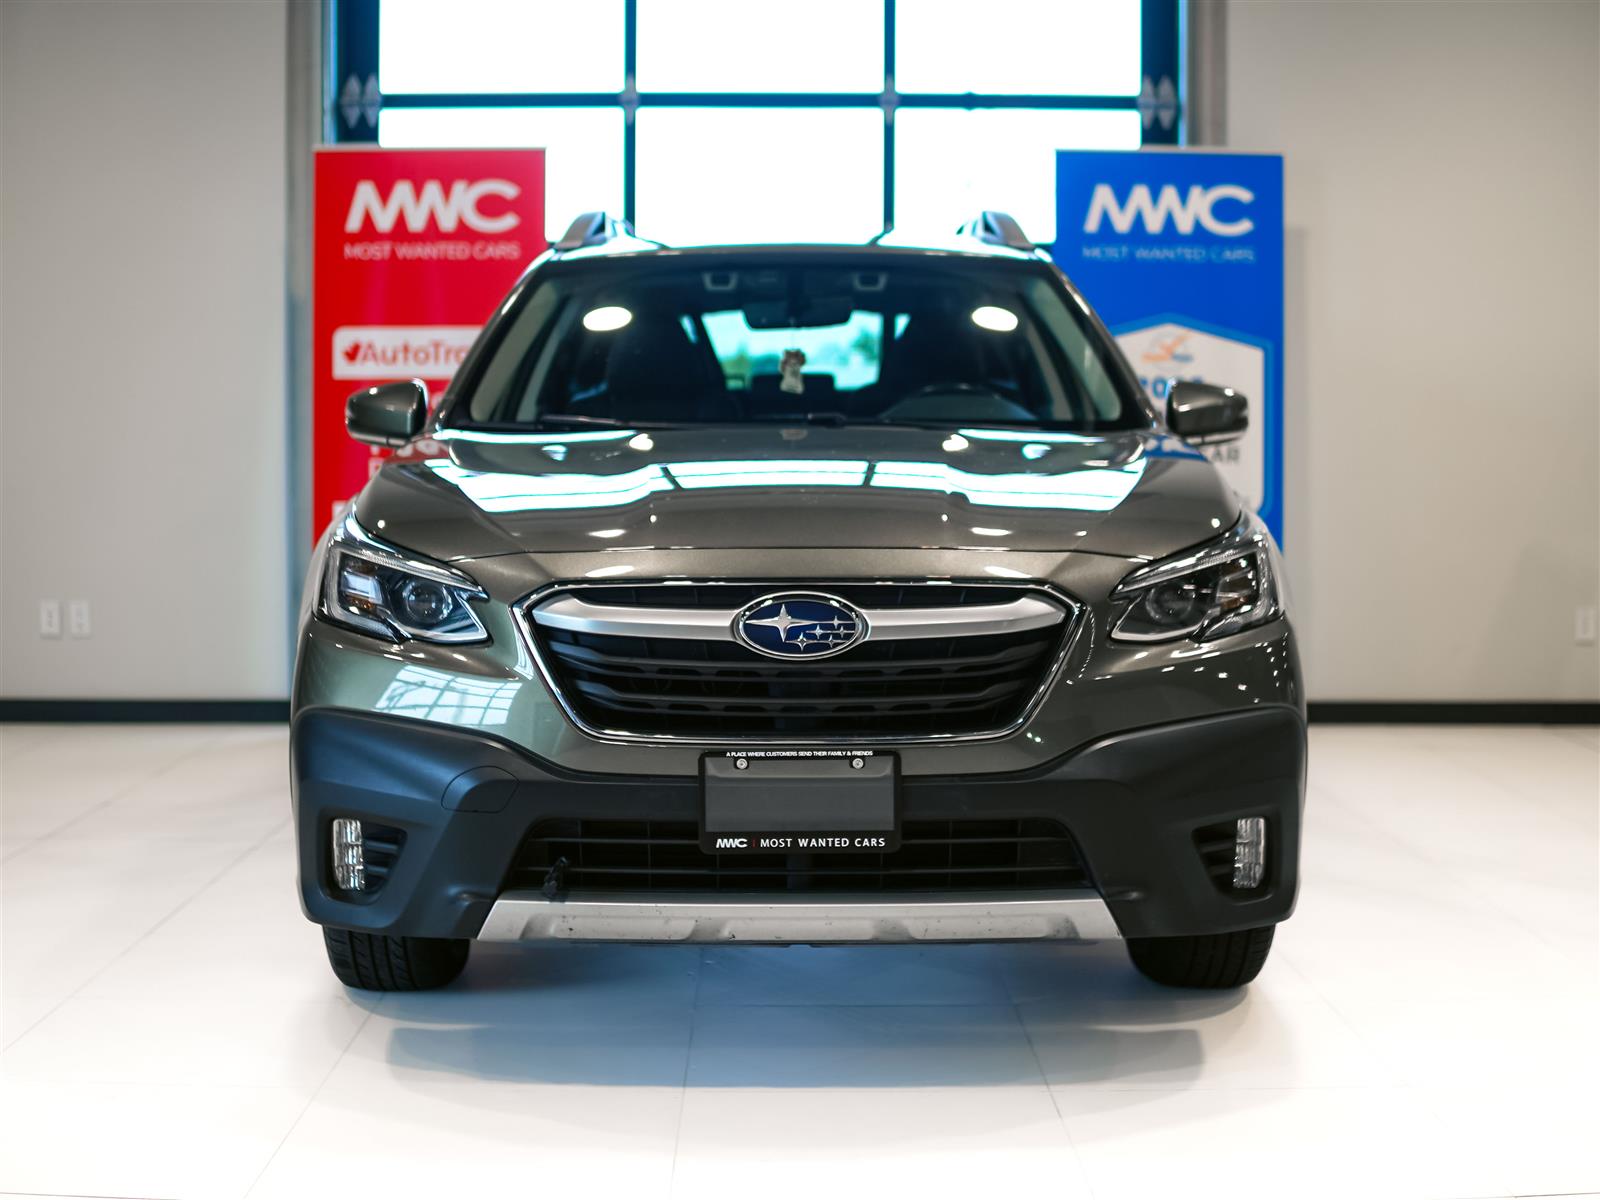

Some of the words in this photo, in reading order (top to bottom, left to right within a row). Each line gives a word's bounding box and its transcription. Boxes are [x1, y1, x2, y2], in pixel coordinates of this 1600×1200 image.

[344, 178, 520, 234] MWC
[1083, 183, 1255, 237] MWC
[344, 241, 391, 261] MOST
[395, 240, 470, 261] WANTED
[473, 240, 521, 260] CARS
[1083, 246, 1128, 260] MOST
[1135, 246, 1205, 261] WANTED
[715, 838, 748, 848] MWC
[760, 838, 793, 848] MOST
[798, 838, 850, 847] WANTED
[854, 838, 886, 847] CARS
